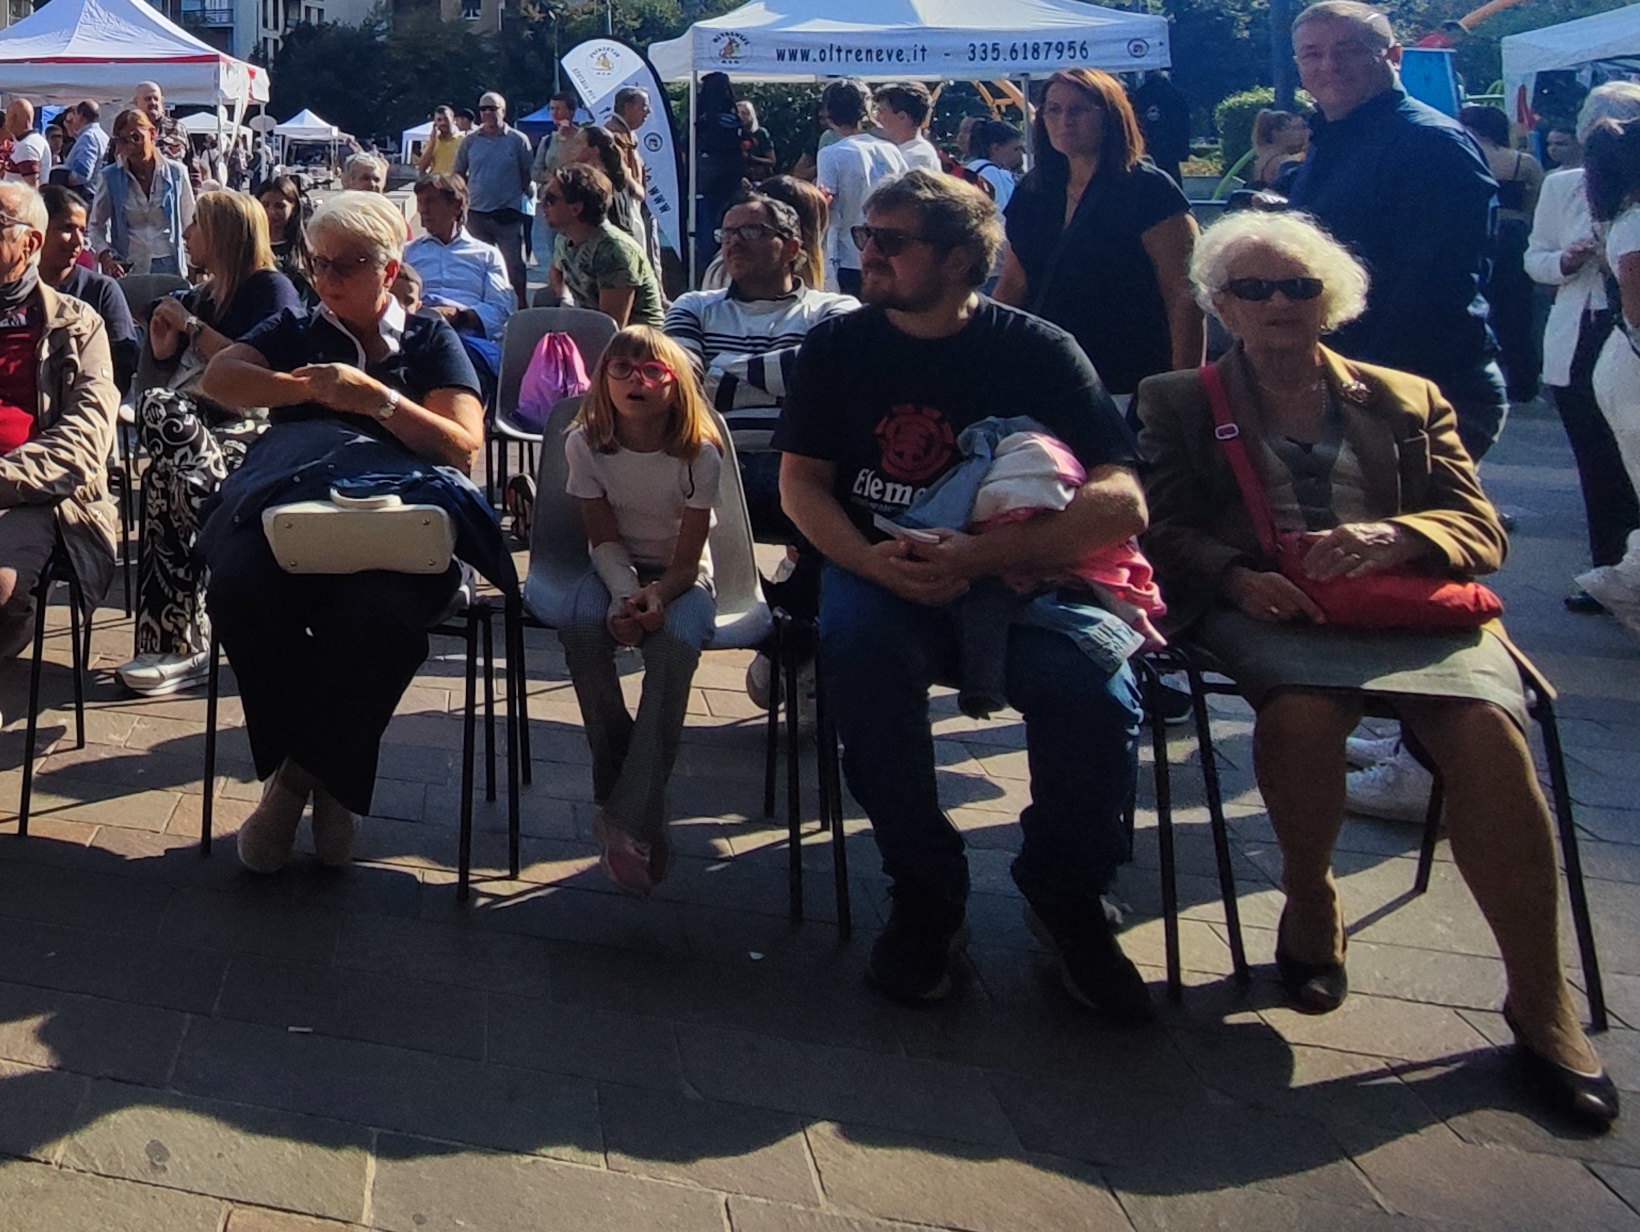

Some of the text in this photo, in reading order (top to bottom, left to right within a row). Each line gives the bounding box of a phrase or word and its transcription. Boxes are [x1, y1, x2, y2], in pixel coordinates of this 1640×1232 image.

[776, 42, 928, 63] www.oltreneve.it
[967, 40, 1090, 62] 335.6187956
[852, 468, 927, 506] Elem
